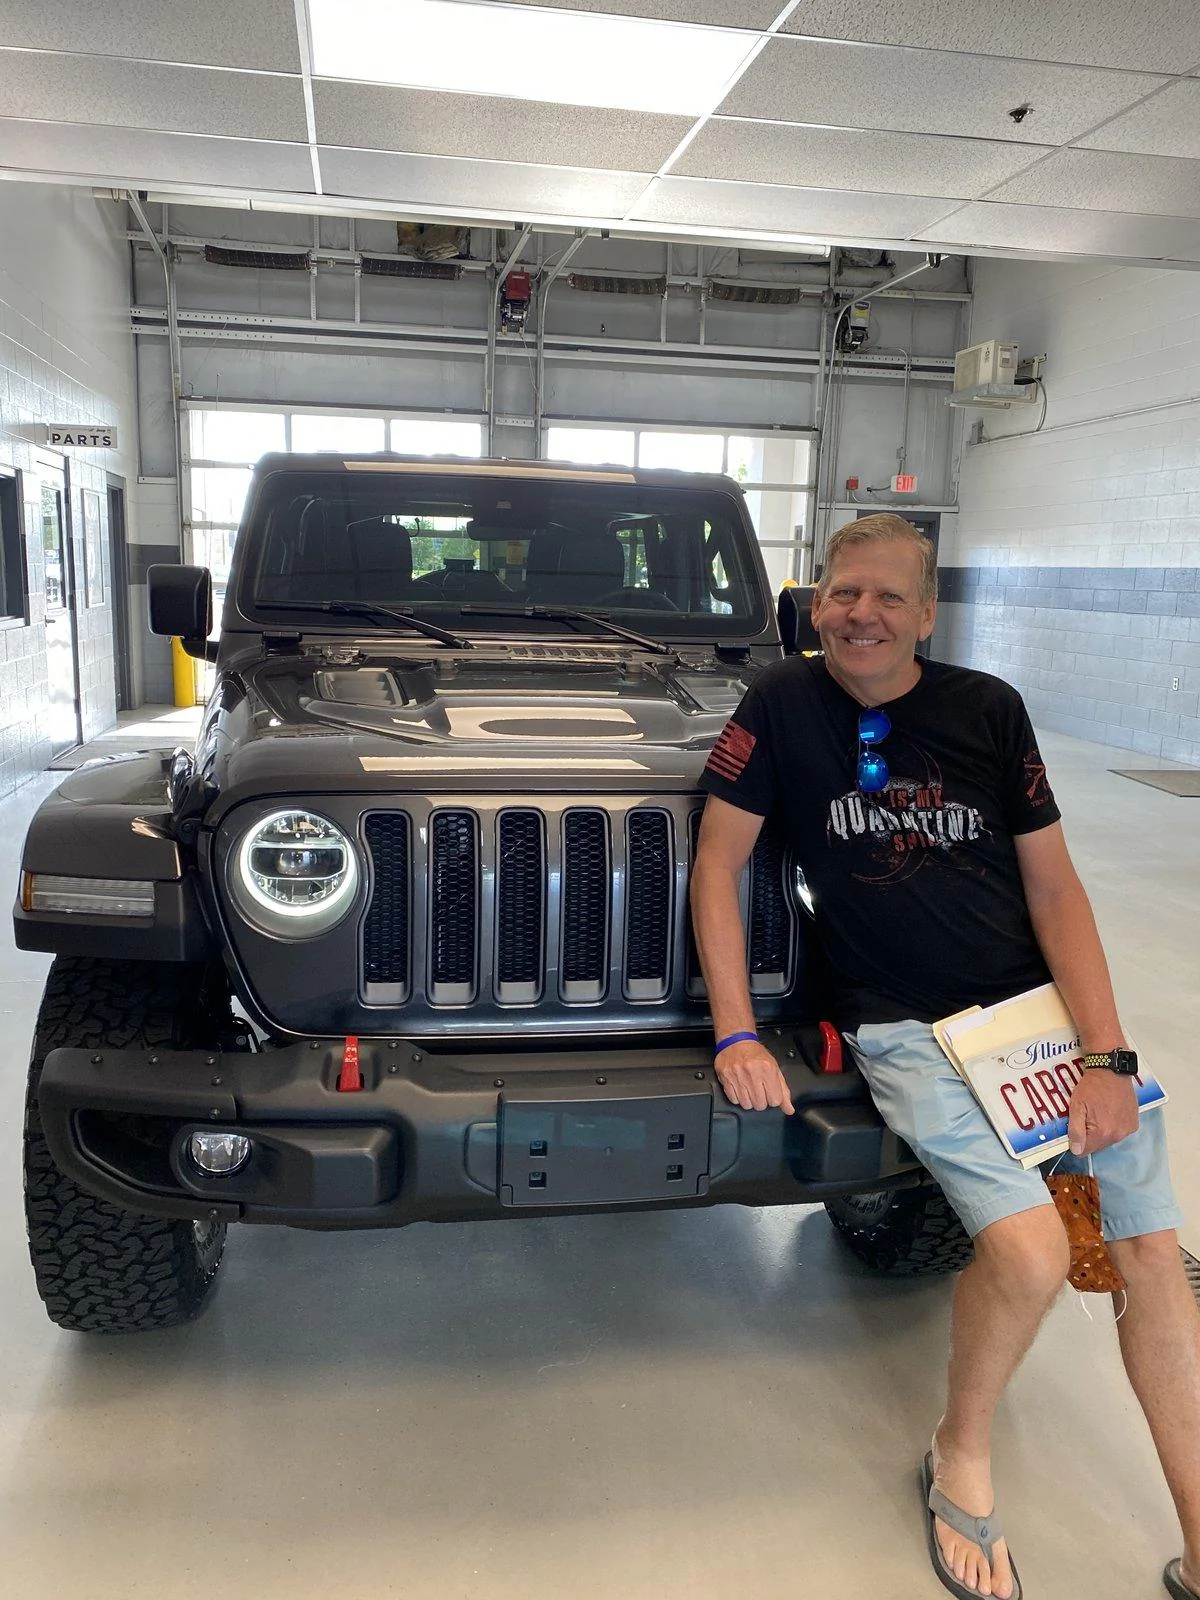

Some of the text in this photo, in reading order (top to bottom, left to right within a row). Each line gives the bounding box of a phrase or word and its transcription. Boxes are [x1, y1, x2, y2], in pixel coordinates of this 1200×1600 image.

[51, 433, 112, 447] PARTS
[896, 476, 915, 491] EXIT
[889, 788, 908, 808] IS
[916, 788, 943, 808] MY
[1006, 1035, 1082, 1069] Illinoi
